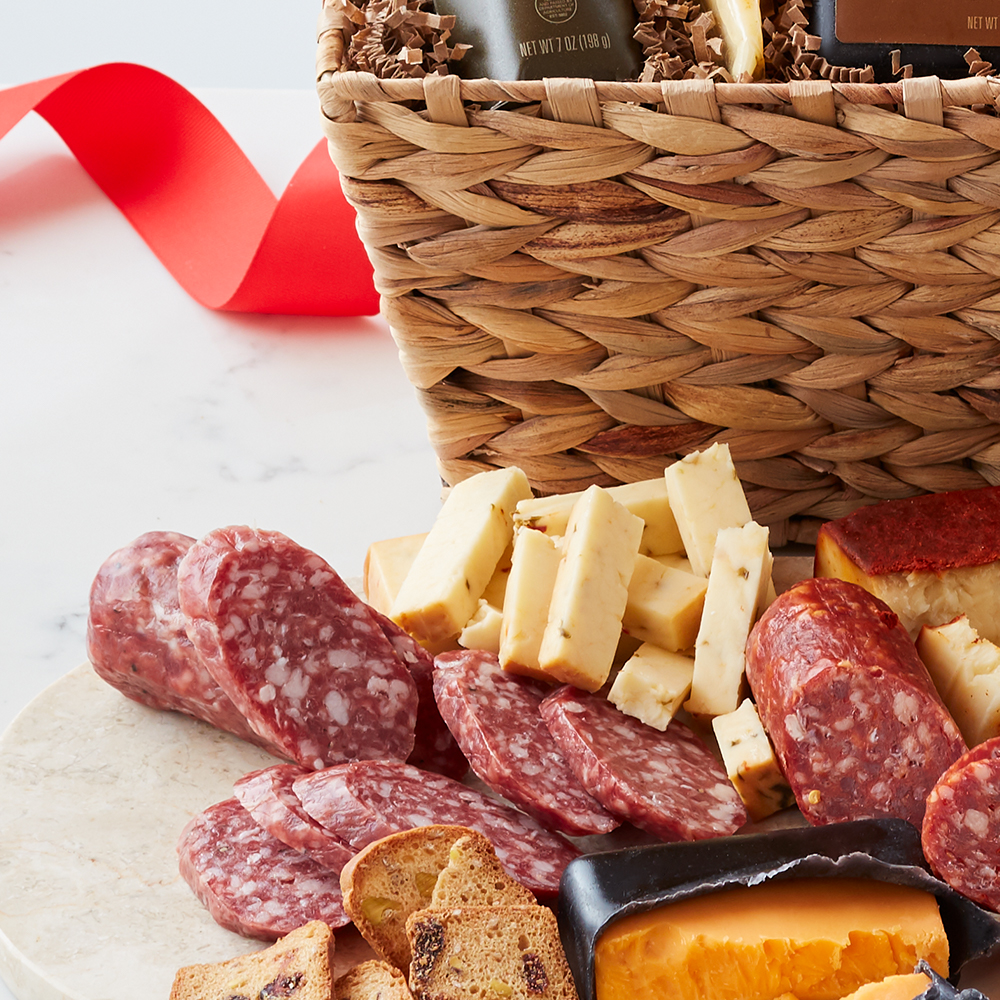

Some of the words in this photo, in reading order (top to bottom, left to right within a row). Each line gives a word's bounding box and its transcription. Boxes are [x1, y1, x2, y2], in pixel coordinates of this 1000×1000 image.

[967, 16, 982, 30] NET
[985, 16, 998, 30] WT
[519, 40, 537, 58] NET
[539, 38, 554, 55] WT
[556, 37, 562, 51] 7
[565, 35, 576, 51] OZ
[578, 33, 600, 50] (198
